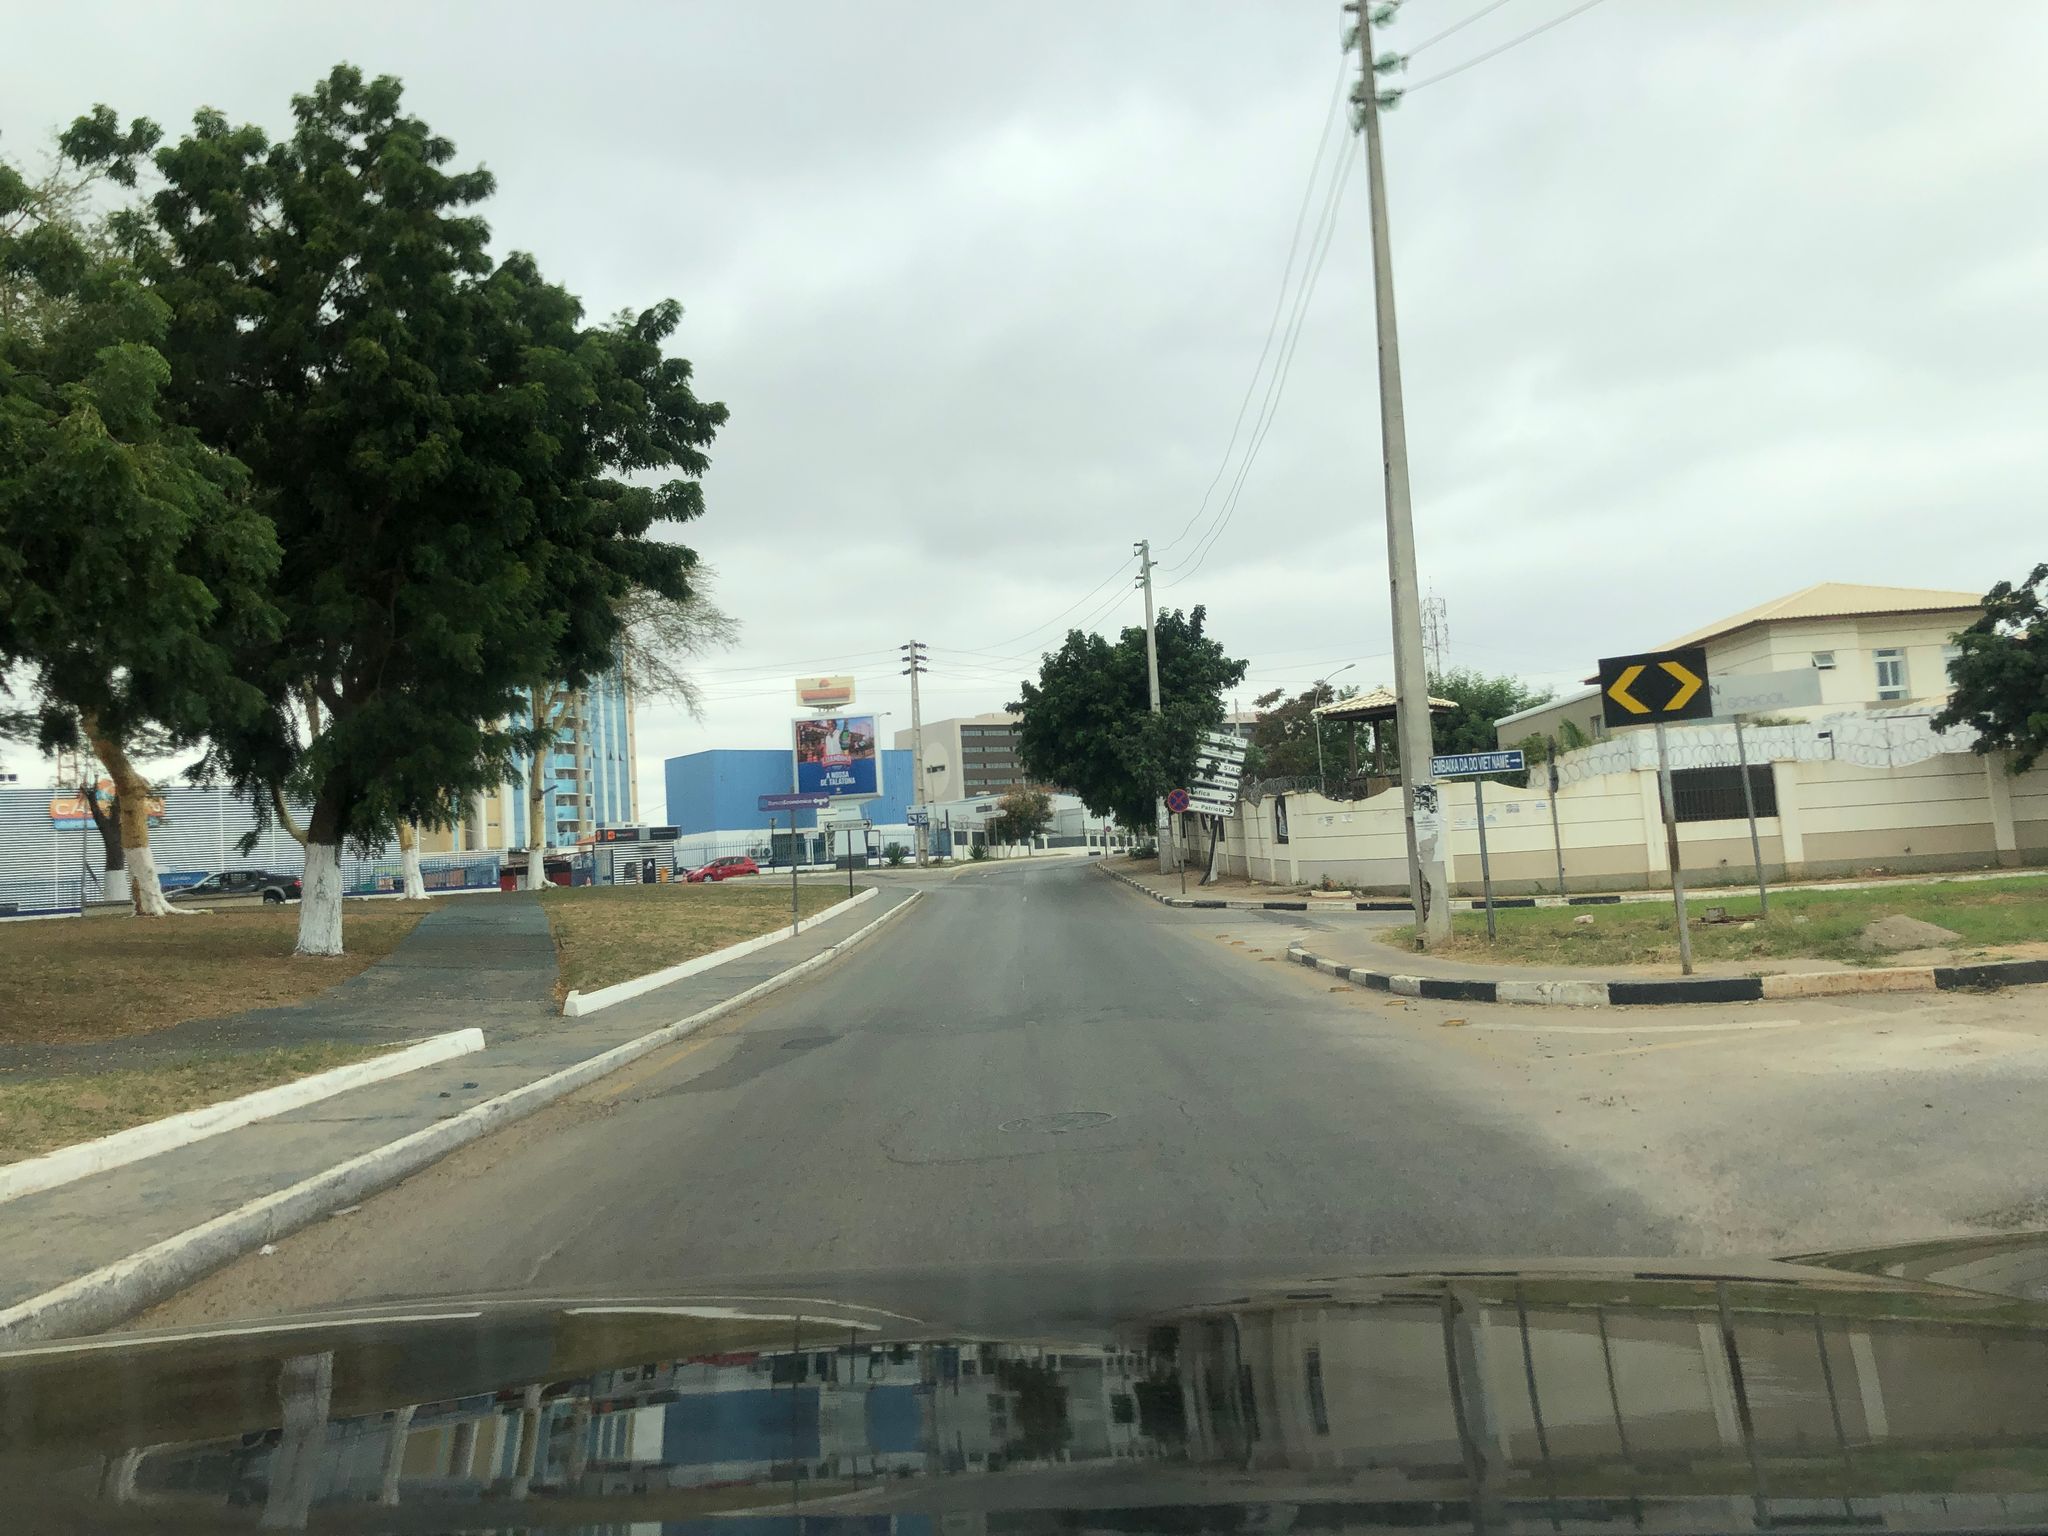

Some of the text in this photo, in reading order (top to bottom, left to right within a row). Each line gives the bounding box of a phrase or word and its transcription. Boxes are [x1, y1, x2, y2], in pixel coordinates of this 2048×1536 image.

[1468, 757, 1478, 771] DO
[1477, 756, 1491, 770] VIET
[1213, 778, 1238, 787] amama
[1201, 804, 1225, 813] Patriota
